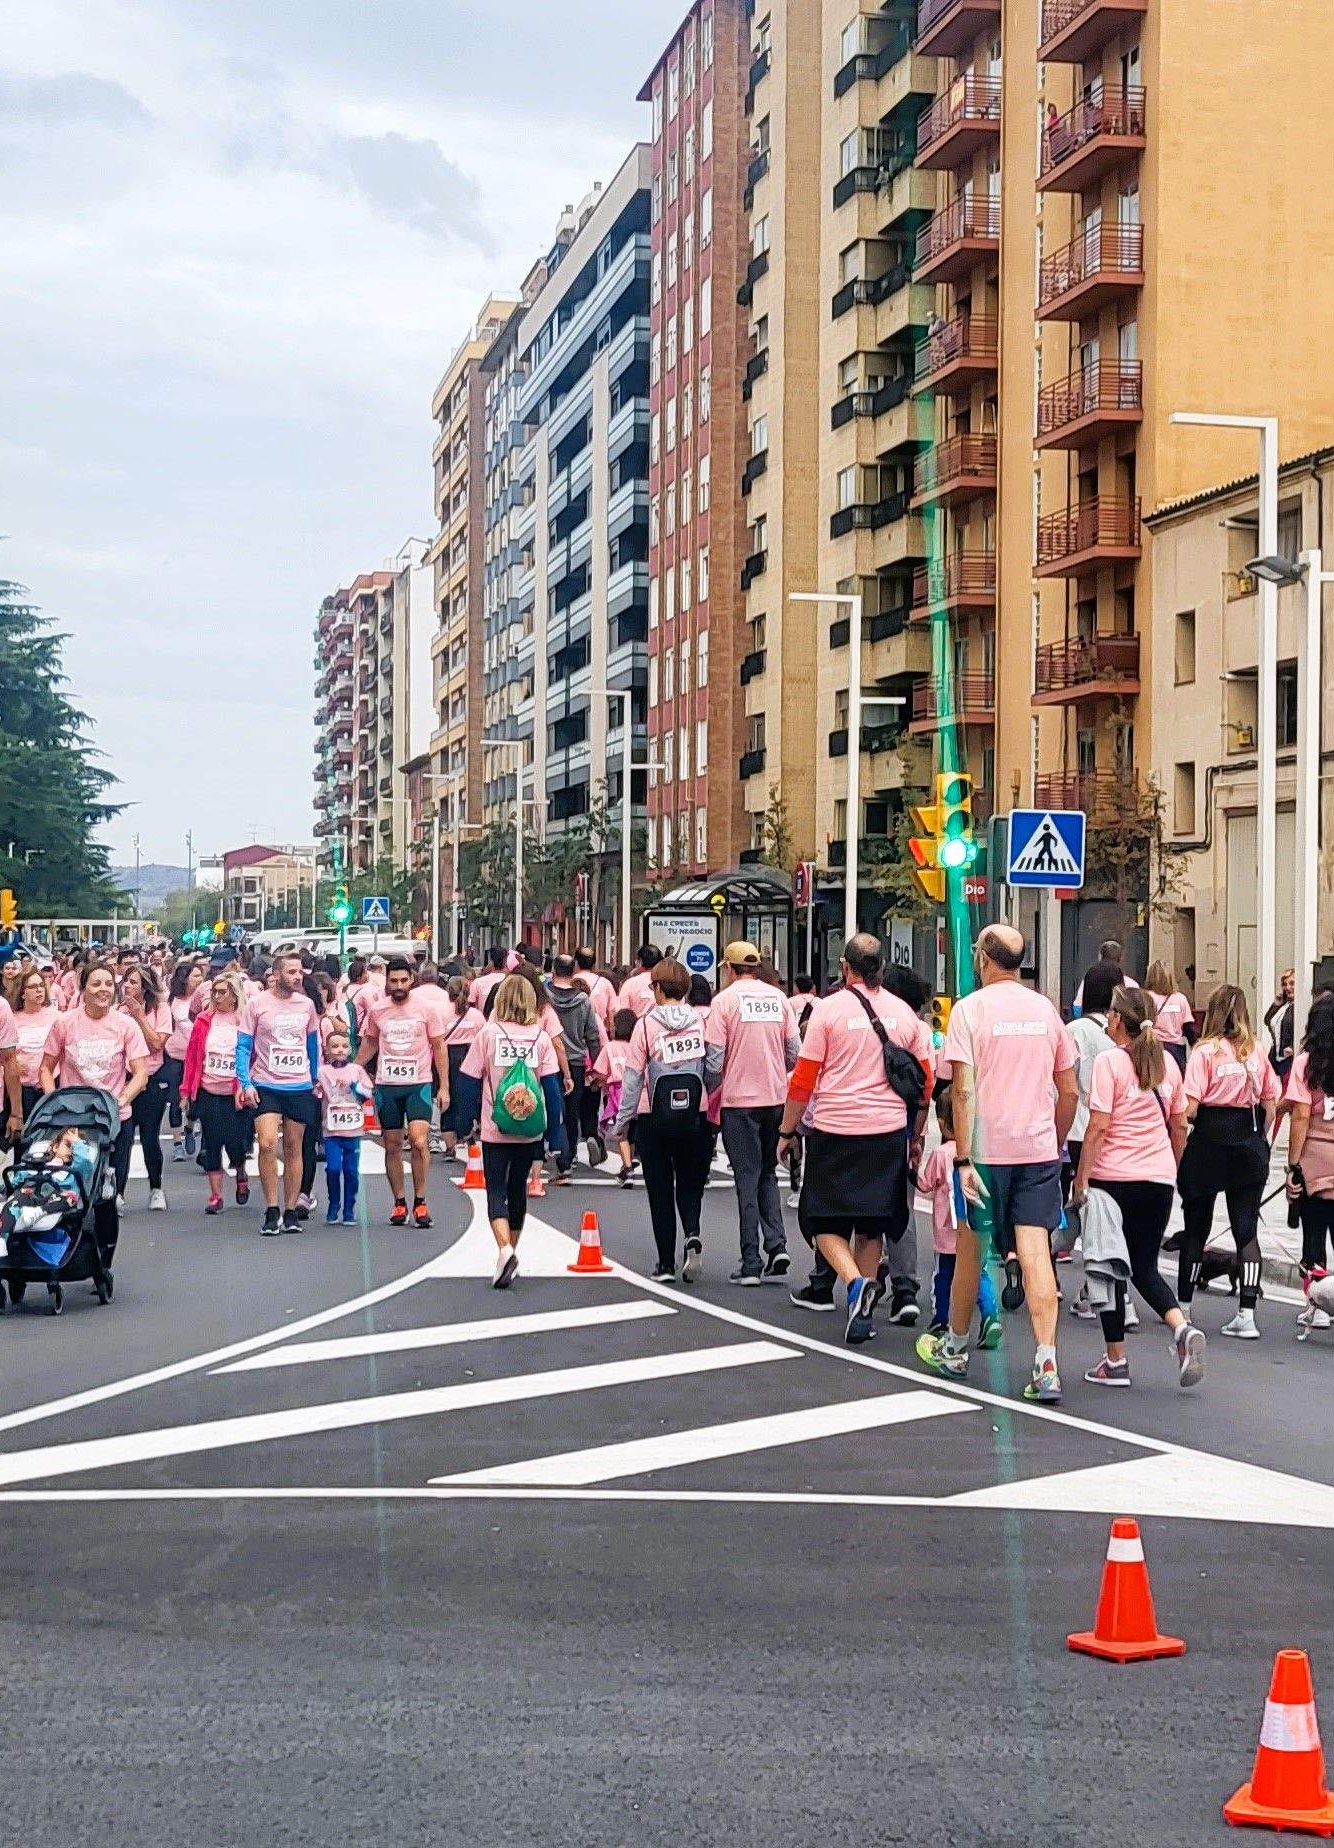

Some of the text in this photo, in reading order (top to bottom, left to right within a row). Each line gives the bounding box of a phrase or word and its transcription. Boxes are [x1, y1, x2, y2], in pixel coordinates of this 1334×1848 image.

[747, 1002, 779, 1013] 1896
[667, 1037, 701, 1054] 1893
[500, 1046, 534, 1059] 3331
[209, 1057, 235, 1070] 3358
[274, 1055, 303, 1066] 1450
[386, 1065, 415, 1076] 1451
[332, 1112, 360, 1124] 1453
